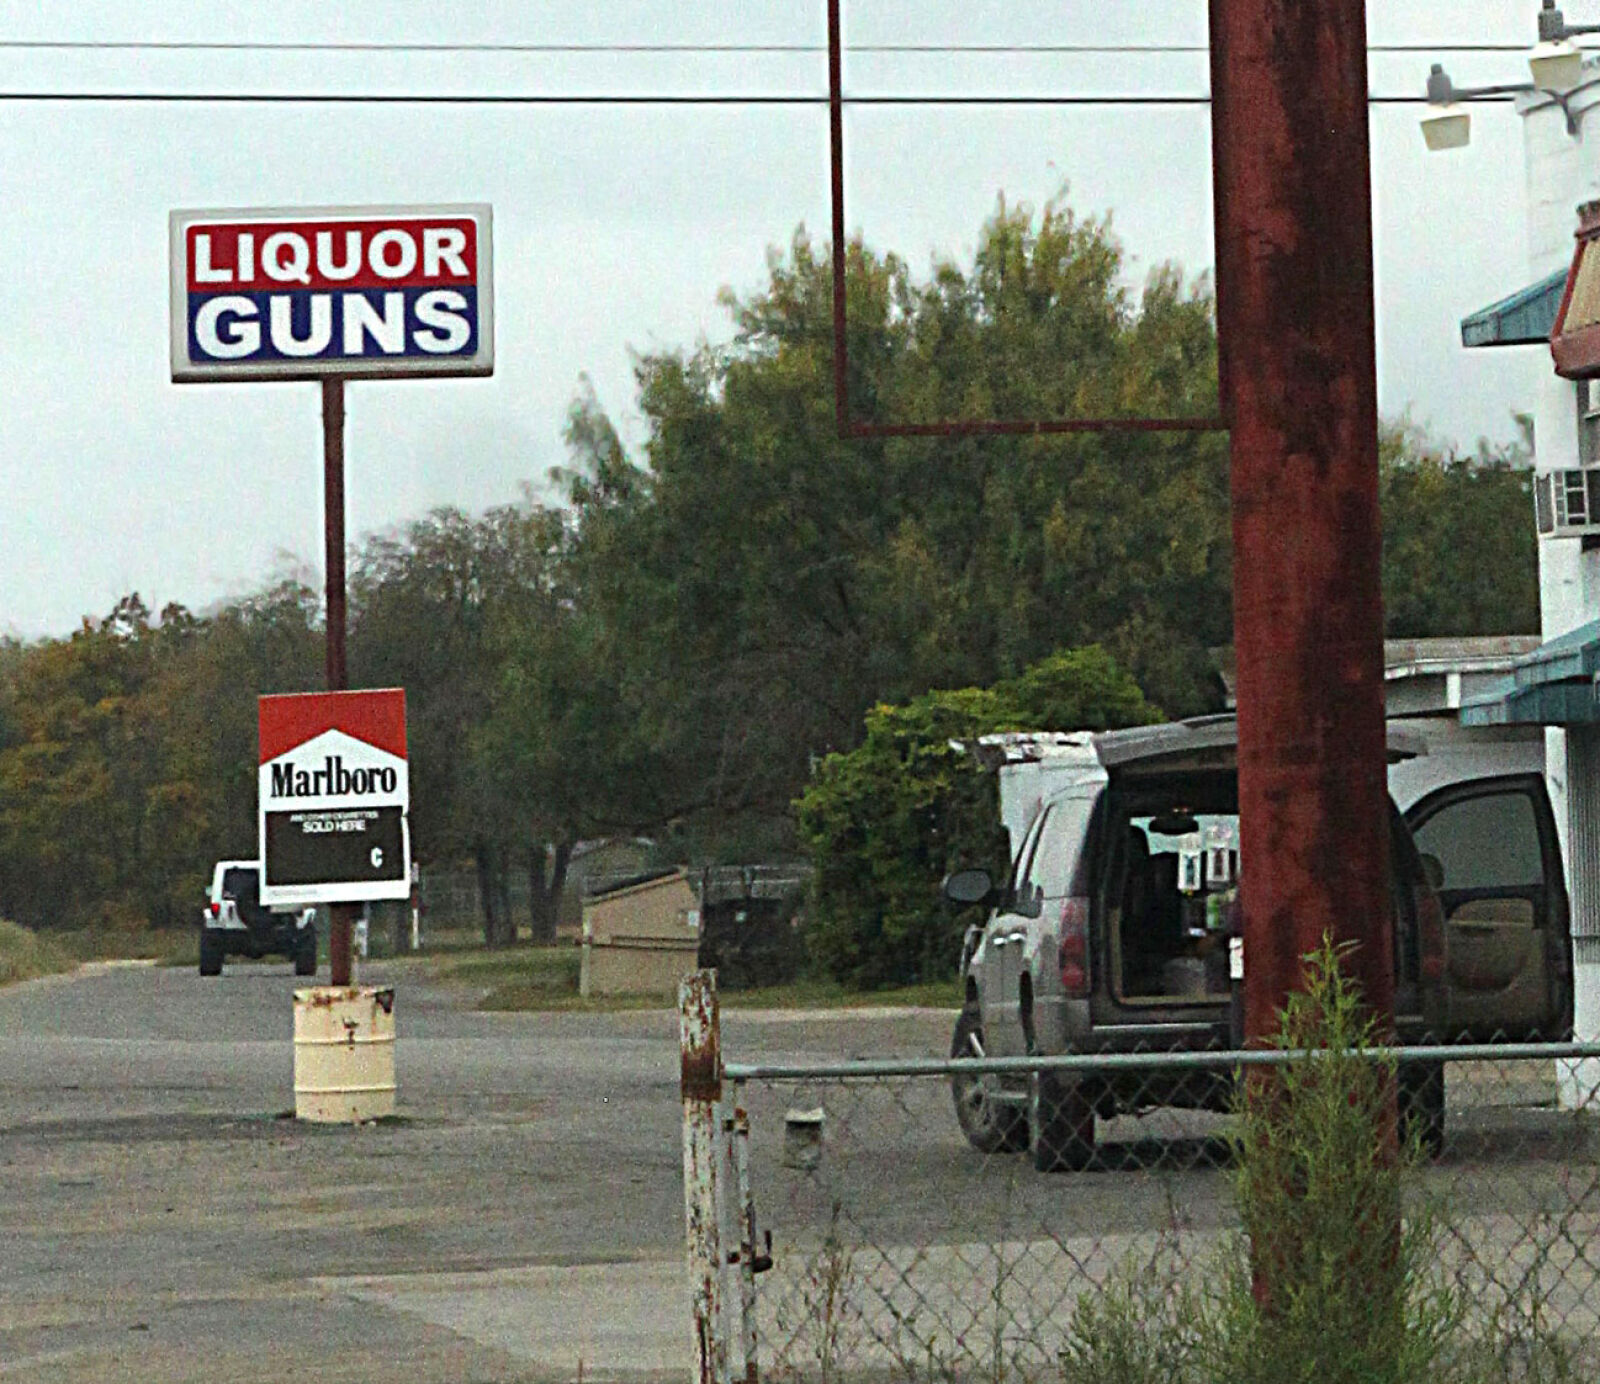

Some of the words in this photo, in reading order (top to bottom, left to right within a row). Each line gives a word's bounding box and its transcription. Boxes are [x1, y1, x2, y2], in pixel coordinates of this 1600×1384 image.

[194, 227, 470, 284] LIQUOR
[194, 290, 471, 358] GUNS
[271, 756, 397, 797] Marlboro
[302, 821, 335, 833] SOLD
[335, 819, 366, 831] HERE
